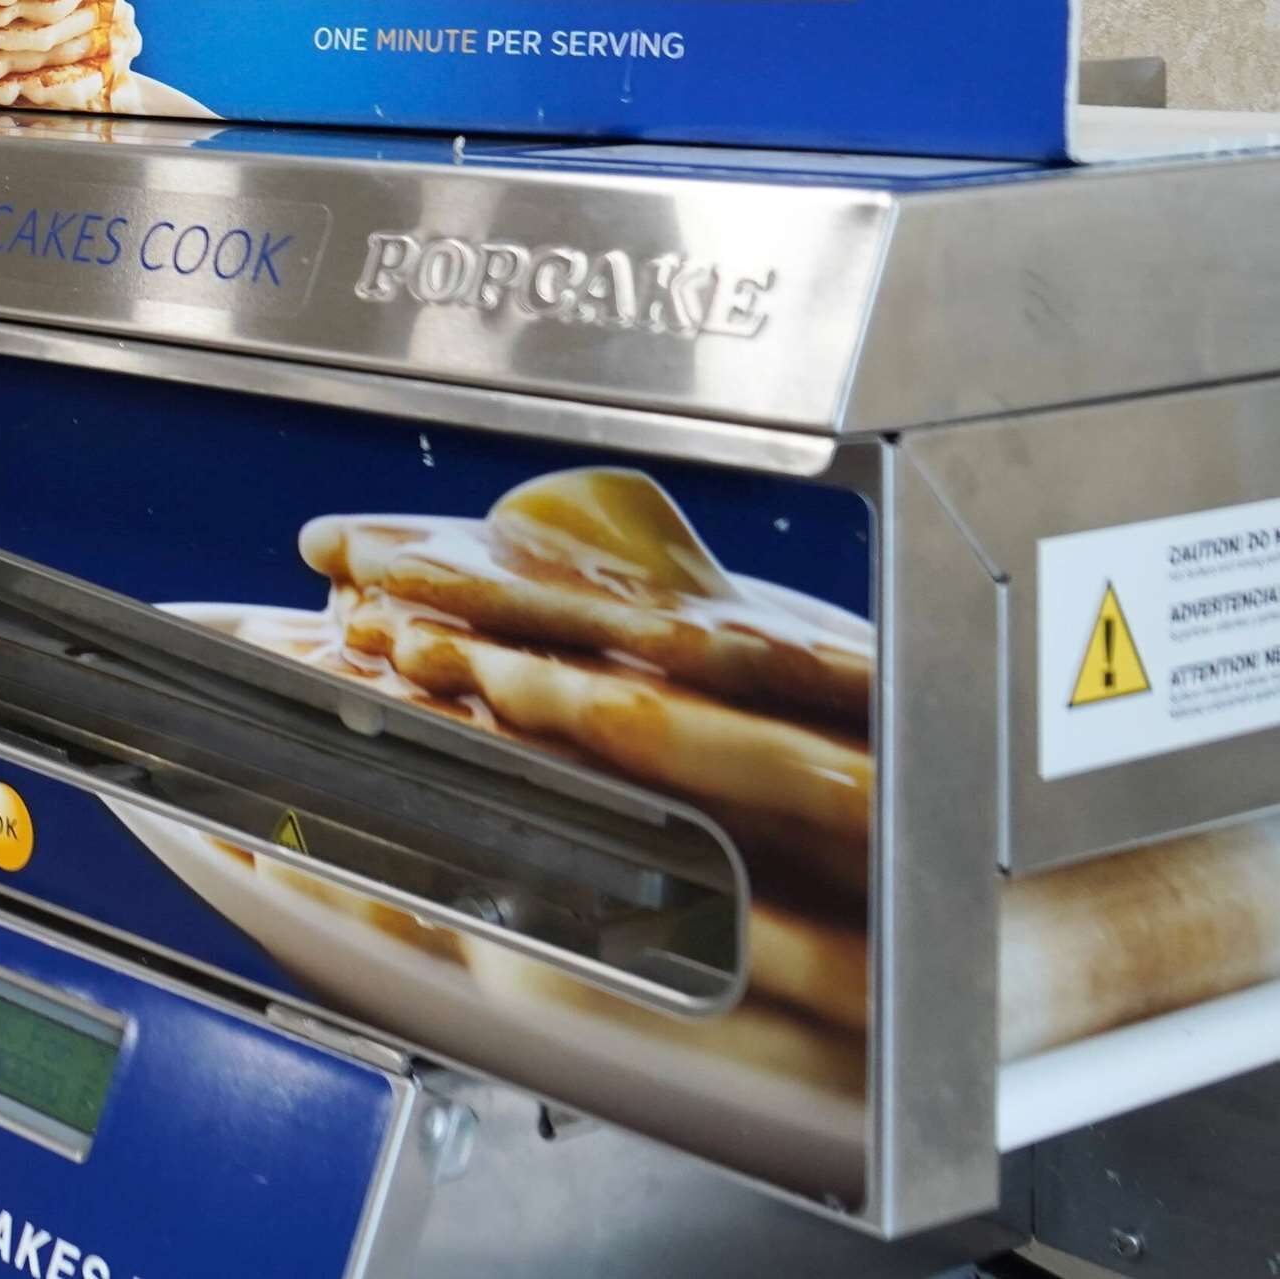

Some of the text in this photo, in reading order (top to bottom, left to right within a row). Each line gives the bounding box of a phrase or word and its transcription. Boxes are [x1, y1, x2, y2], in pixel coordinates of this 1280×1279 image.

[313, 26, 686, 59] ONE MINUTE PER SERVING
[139, 222, 294, 288] COOK
[353, 231, 778, 340] POPCAKE
